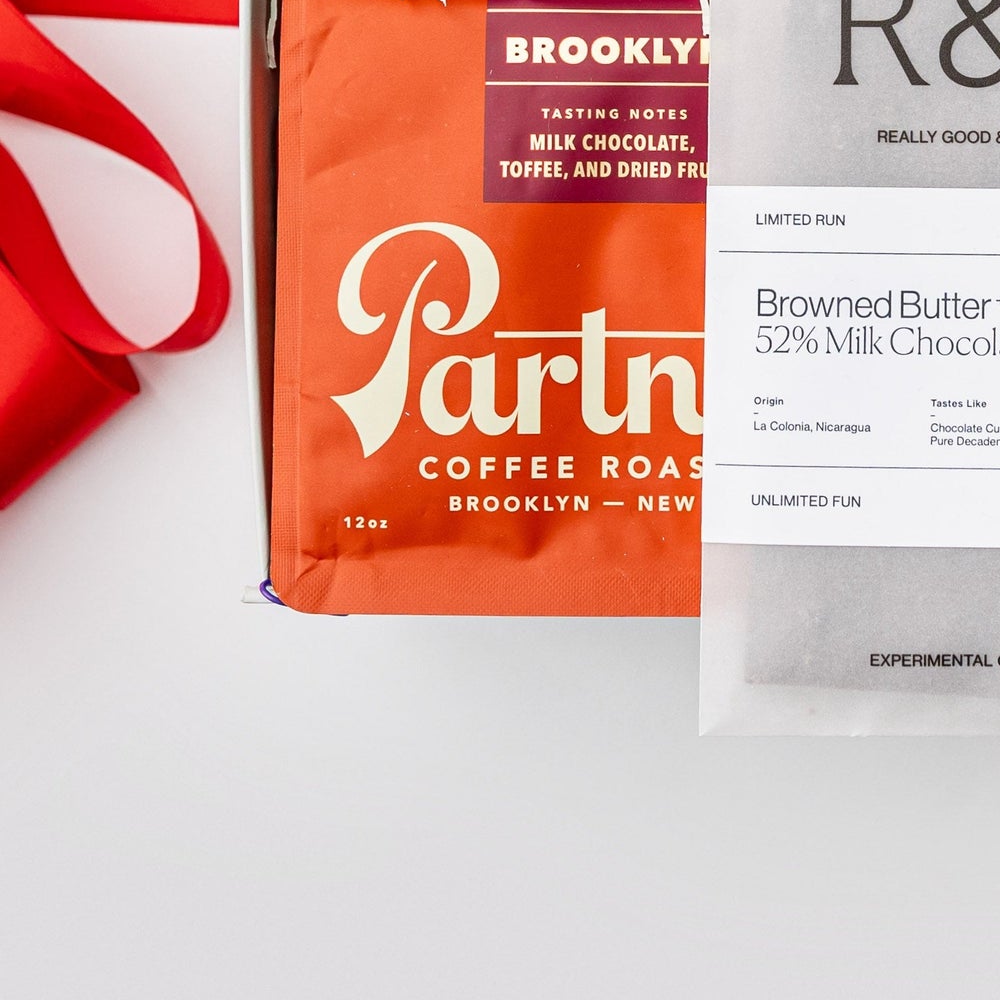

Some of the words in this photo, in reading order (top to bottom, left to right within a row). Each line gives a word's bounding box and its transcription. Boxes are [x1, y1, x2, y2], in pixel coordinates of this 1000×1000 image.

[542, 108, 619, 120] TASTING
[630, 109, 688, 120] NOTES
[530, 134, 576, 151] MILK
[583, 135, 695, 154] CHOCOLATE,
[877, 130, 937, 145] REALLY
[942, 130, 991, 144] GOOD
[500, 160, 569, 180] TOFFEE,
[574, 161, 611, 178] AND
[618, 161, 672, 178] DRIED
[755, 214, 811, 226] LIMITED
[816, 214, 846, 226] RUN
[757, 289, 892, 319] Browned
[900, 291, 991, 319] Butter
[755, 325, 818, 355] 52%
[825, 326, 883, 355] Milk
[754, 397, 784, 407] Origin
[931, 399, 963, 408] Tastes
[967, 400, 987, 408] Like
[754, 422, 766, 432] La
[770, 422, 813, 433] Colonia,
[816, 422, 871, 434] Nicaragua
[930, 424, 982, 434] Chocolate
[930, 437, 953, 446] Pure
[419, 456, 575, 480] COFFEE
[449, 496, 589, 511] BROOKLYN
[638, 496, 695, 511] NEW
[751, 494, 828, 507] UNLIMITED
[832, 495, 861, 508] FUN
[344, 517, 388, 529] 12oz
[870, 653, 992, 668] EXPERIMENTAL
